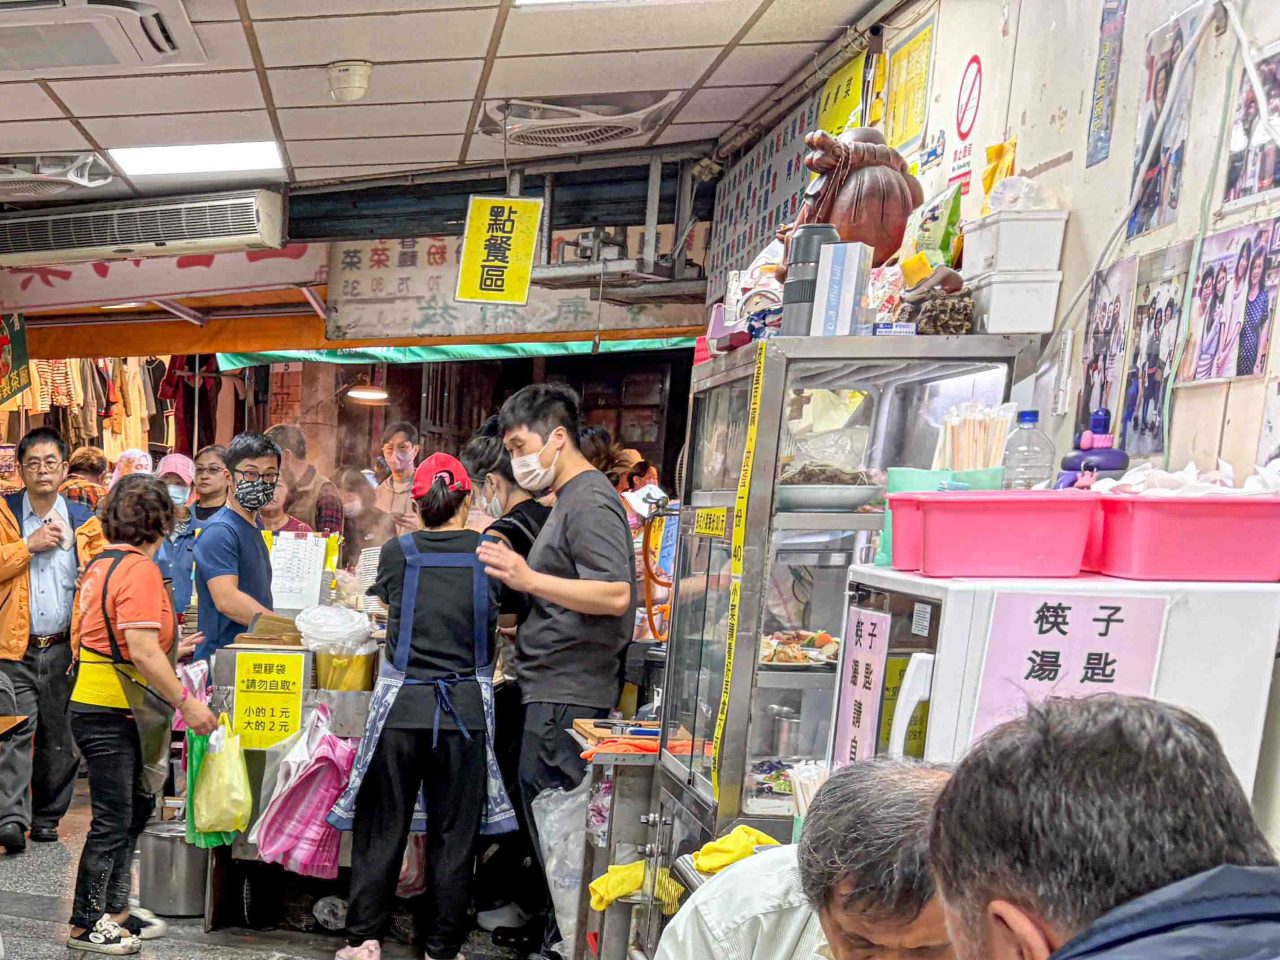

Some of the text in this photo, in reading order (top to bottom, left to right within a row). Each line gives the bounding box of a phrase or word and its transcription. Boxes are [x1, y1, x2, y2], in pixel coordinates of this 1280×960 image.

[479, 205, 518, 292] 點餐區
[733, 545, 741, 562] 40
[1034, 602, 1124, 637] 筷子
[252, 663, 286, 674] 塑膠袋
[1024, 650, 1117, 684] 湯匙
[244, 706, 266, 718] 小的
[280, 707, 290, 718] 元
[244, 720, 265, 731] 大的
[279, 721, 290, 732] 元
